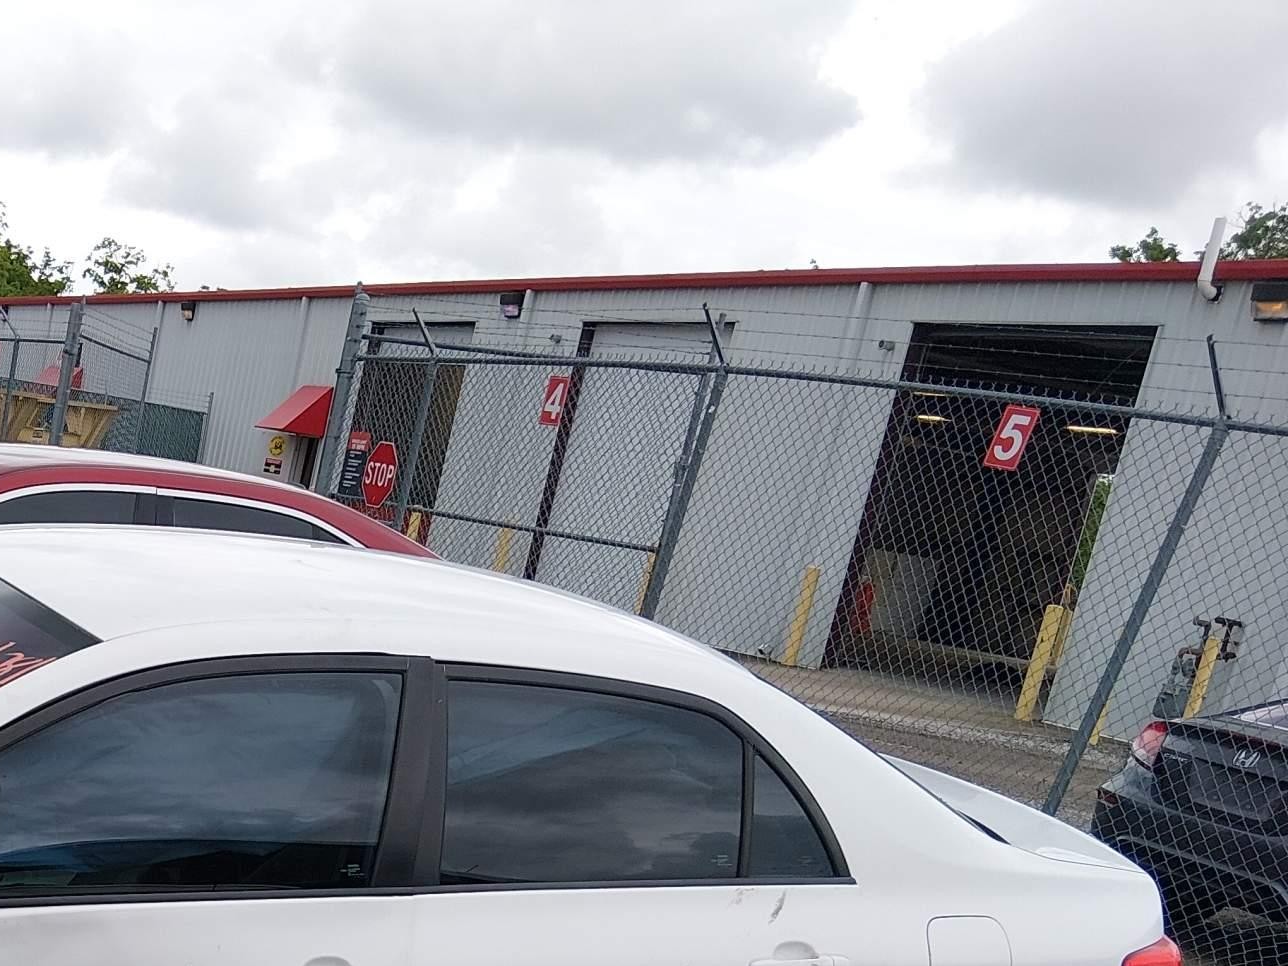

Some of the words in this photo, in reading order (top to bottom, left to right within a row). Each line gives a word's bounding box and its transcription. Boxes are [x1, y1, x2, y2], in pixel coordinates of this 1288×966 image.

[543, 382, 565, 420] 4
[993, 414, 1032, 461] 5
[364, 461, 395, 488] STOP
